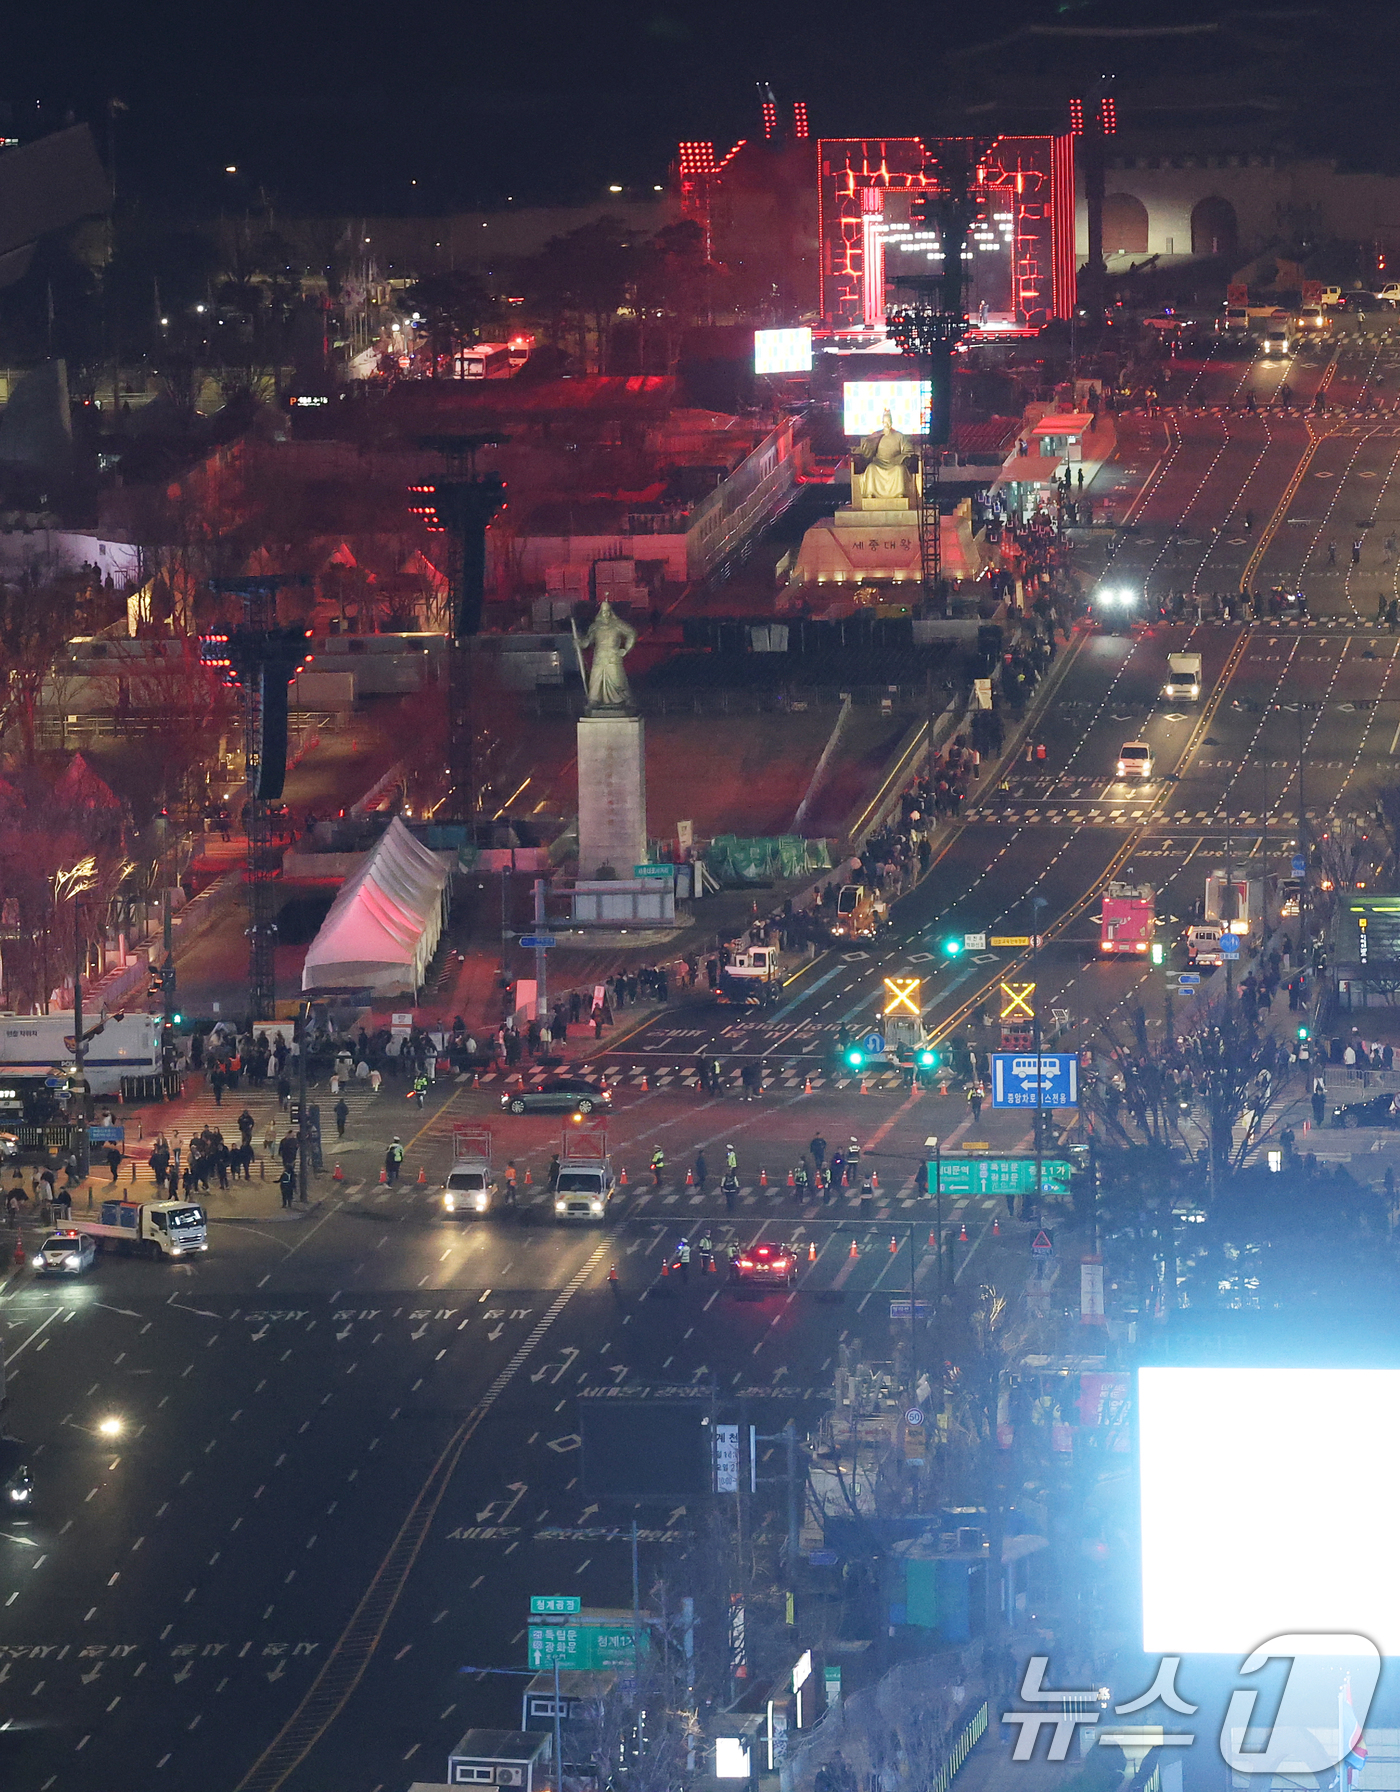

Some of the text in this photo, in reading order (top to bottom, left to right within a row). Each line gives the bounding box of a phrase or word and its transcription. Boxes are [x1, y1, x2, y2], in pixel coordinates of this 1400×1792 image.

[851, 538, 912, 552] 세종대왕
[1007, 1093, 1066, 1104] 중앙차로스전용
[990, 1173, 1019, 1182] 광화문
[536, 1600, 575, 1611] 청계광장
[545, 1629, 577, 1641] 독립문
[545, 1641, 577, 1653] 광화문
